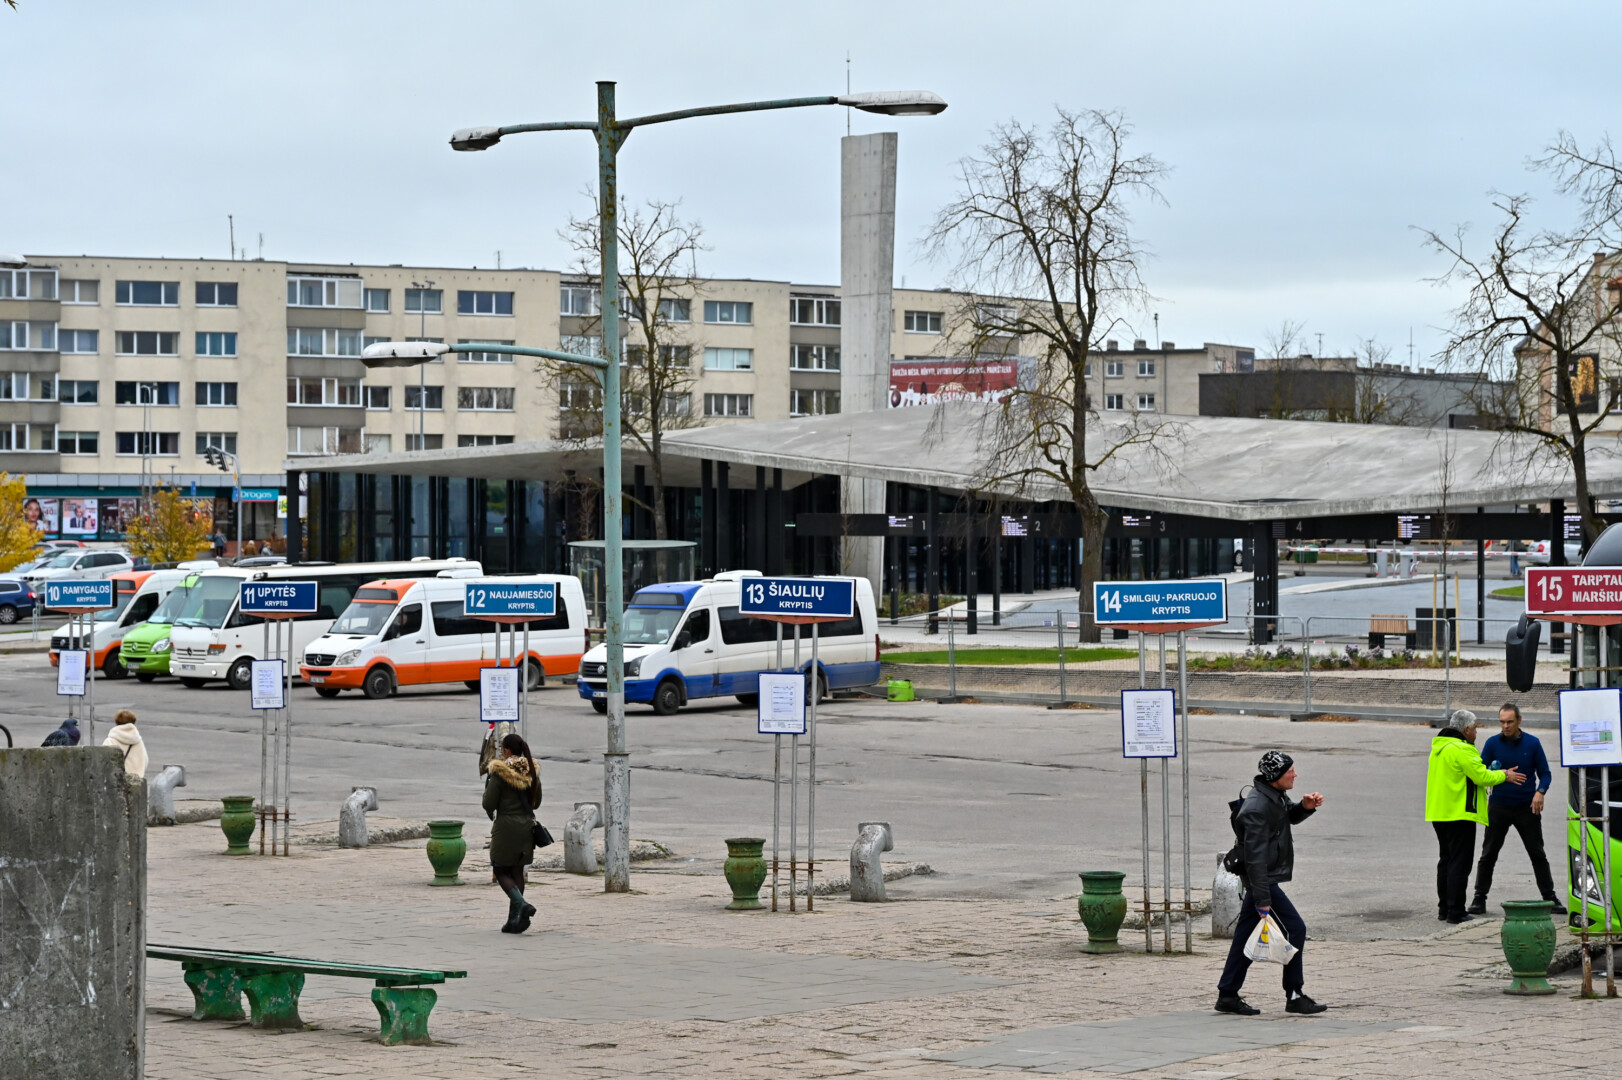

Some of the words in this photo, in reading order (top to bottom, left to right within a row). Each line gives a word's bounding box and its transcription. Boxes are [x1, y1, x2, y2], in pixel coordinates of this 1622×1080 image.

[240, 490, 272, 500] Drogas
[1034, 520, 1041, 532] 2
[1159, 520, 1166, 532] 3
[48, 585, 60, 602] 10
[62, 585, 110, 595] RAMYGALOS
[257, 585, 296, 598] UPYTĖS
[489, 588, 553, 599] NAUJAMIESČIO
[746, 583, 765, 604] 13
[768, 582, 825, 601] ŠIAULIŲ
[1537, 576, 1563, 601] 15
[244, 587, 255, 604] 11
[468, 589, 486, 608] 12
[1100, 590, 1122, 613] 14
[1122, 594, 1160, 604] SMILGIŲ
[1166, 592, 1217, 602] PAKRUOJO
[1572, 589, 1622, 602] MARŠRU
[507, 602, 535, 610] KRYPTIS
[779, 601, 813, 609] KRYPTIS
[1151, 605, 1191, 615] KRYPTIS
